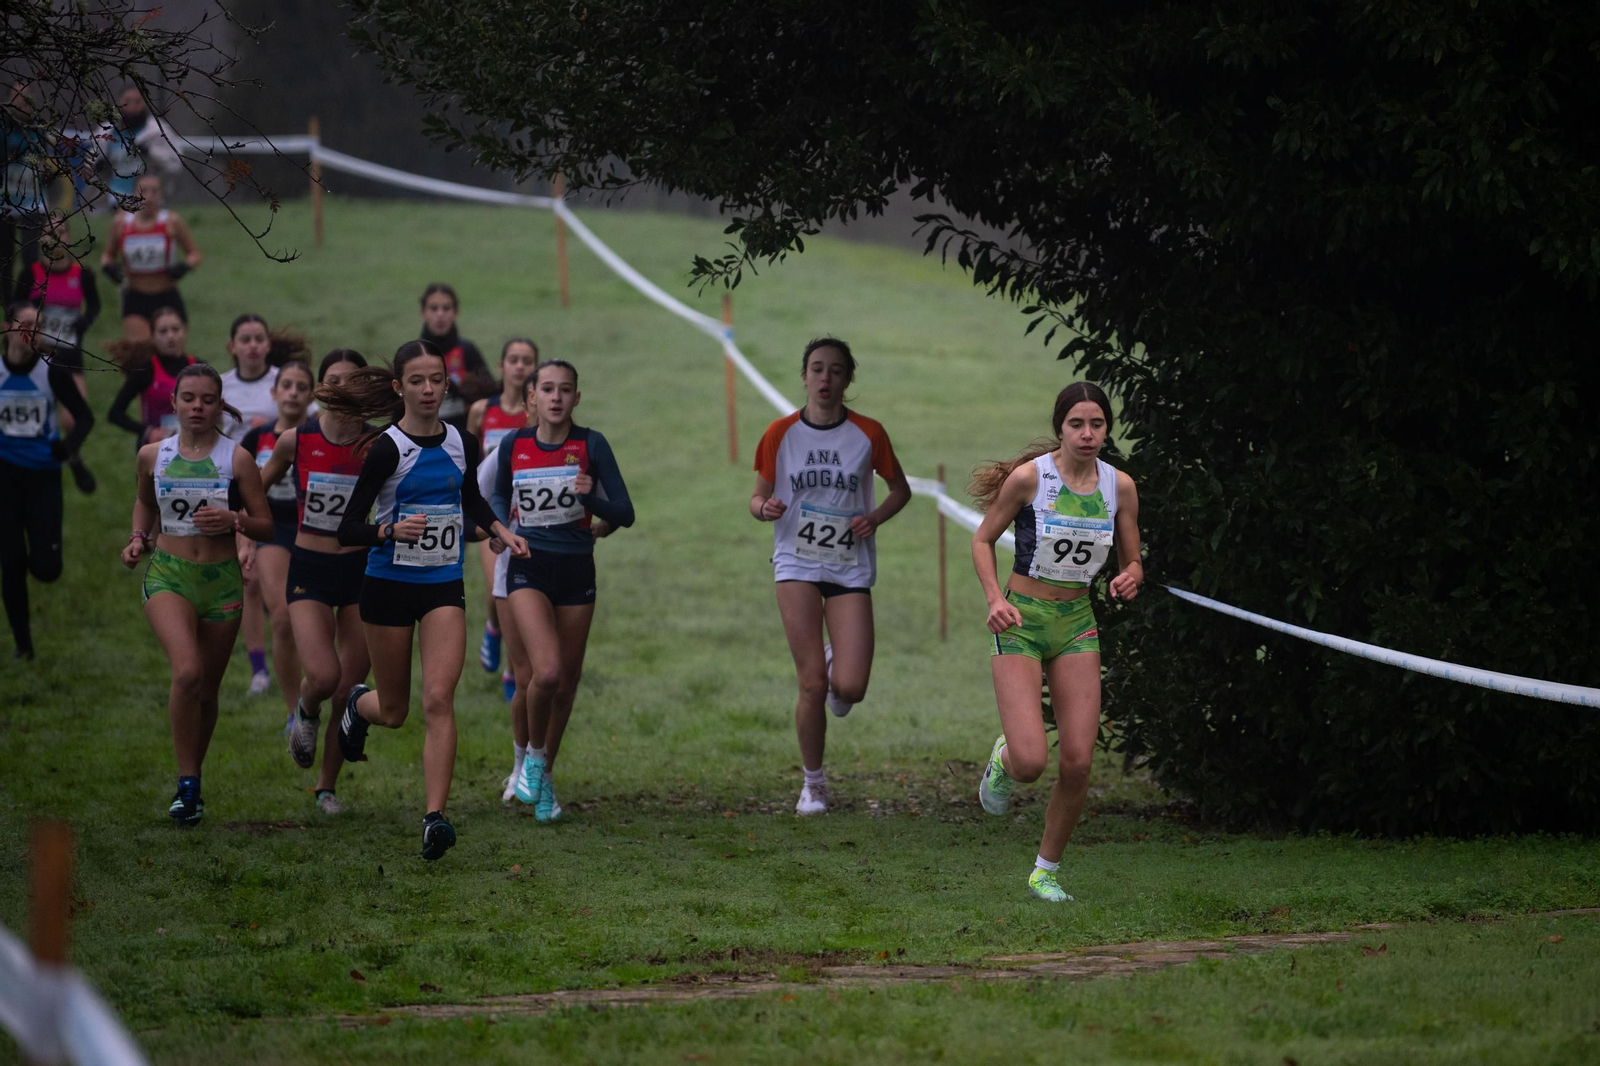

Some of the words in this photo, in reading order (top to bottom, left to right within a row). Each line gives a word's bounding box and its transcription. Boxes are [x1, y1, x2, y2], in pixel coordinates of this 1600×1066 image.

[0, 406, 40, 424] 451
[805, 449, 842, 466] ANA
[790, 470, 858, 492] MOGAS
[518, 487, 577, 512] 526
[797, 521, 855, 550] 424
[1053, 539, 1095, 565] 95
